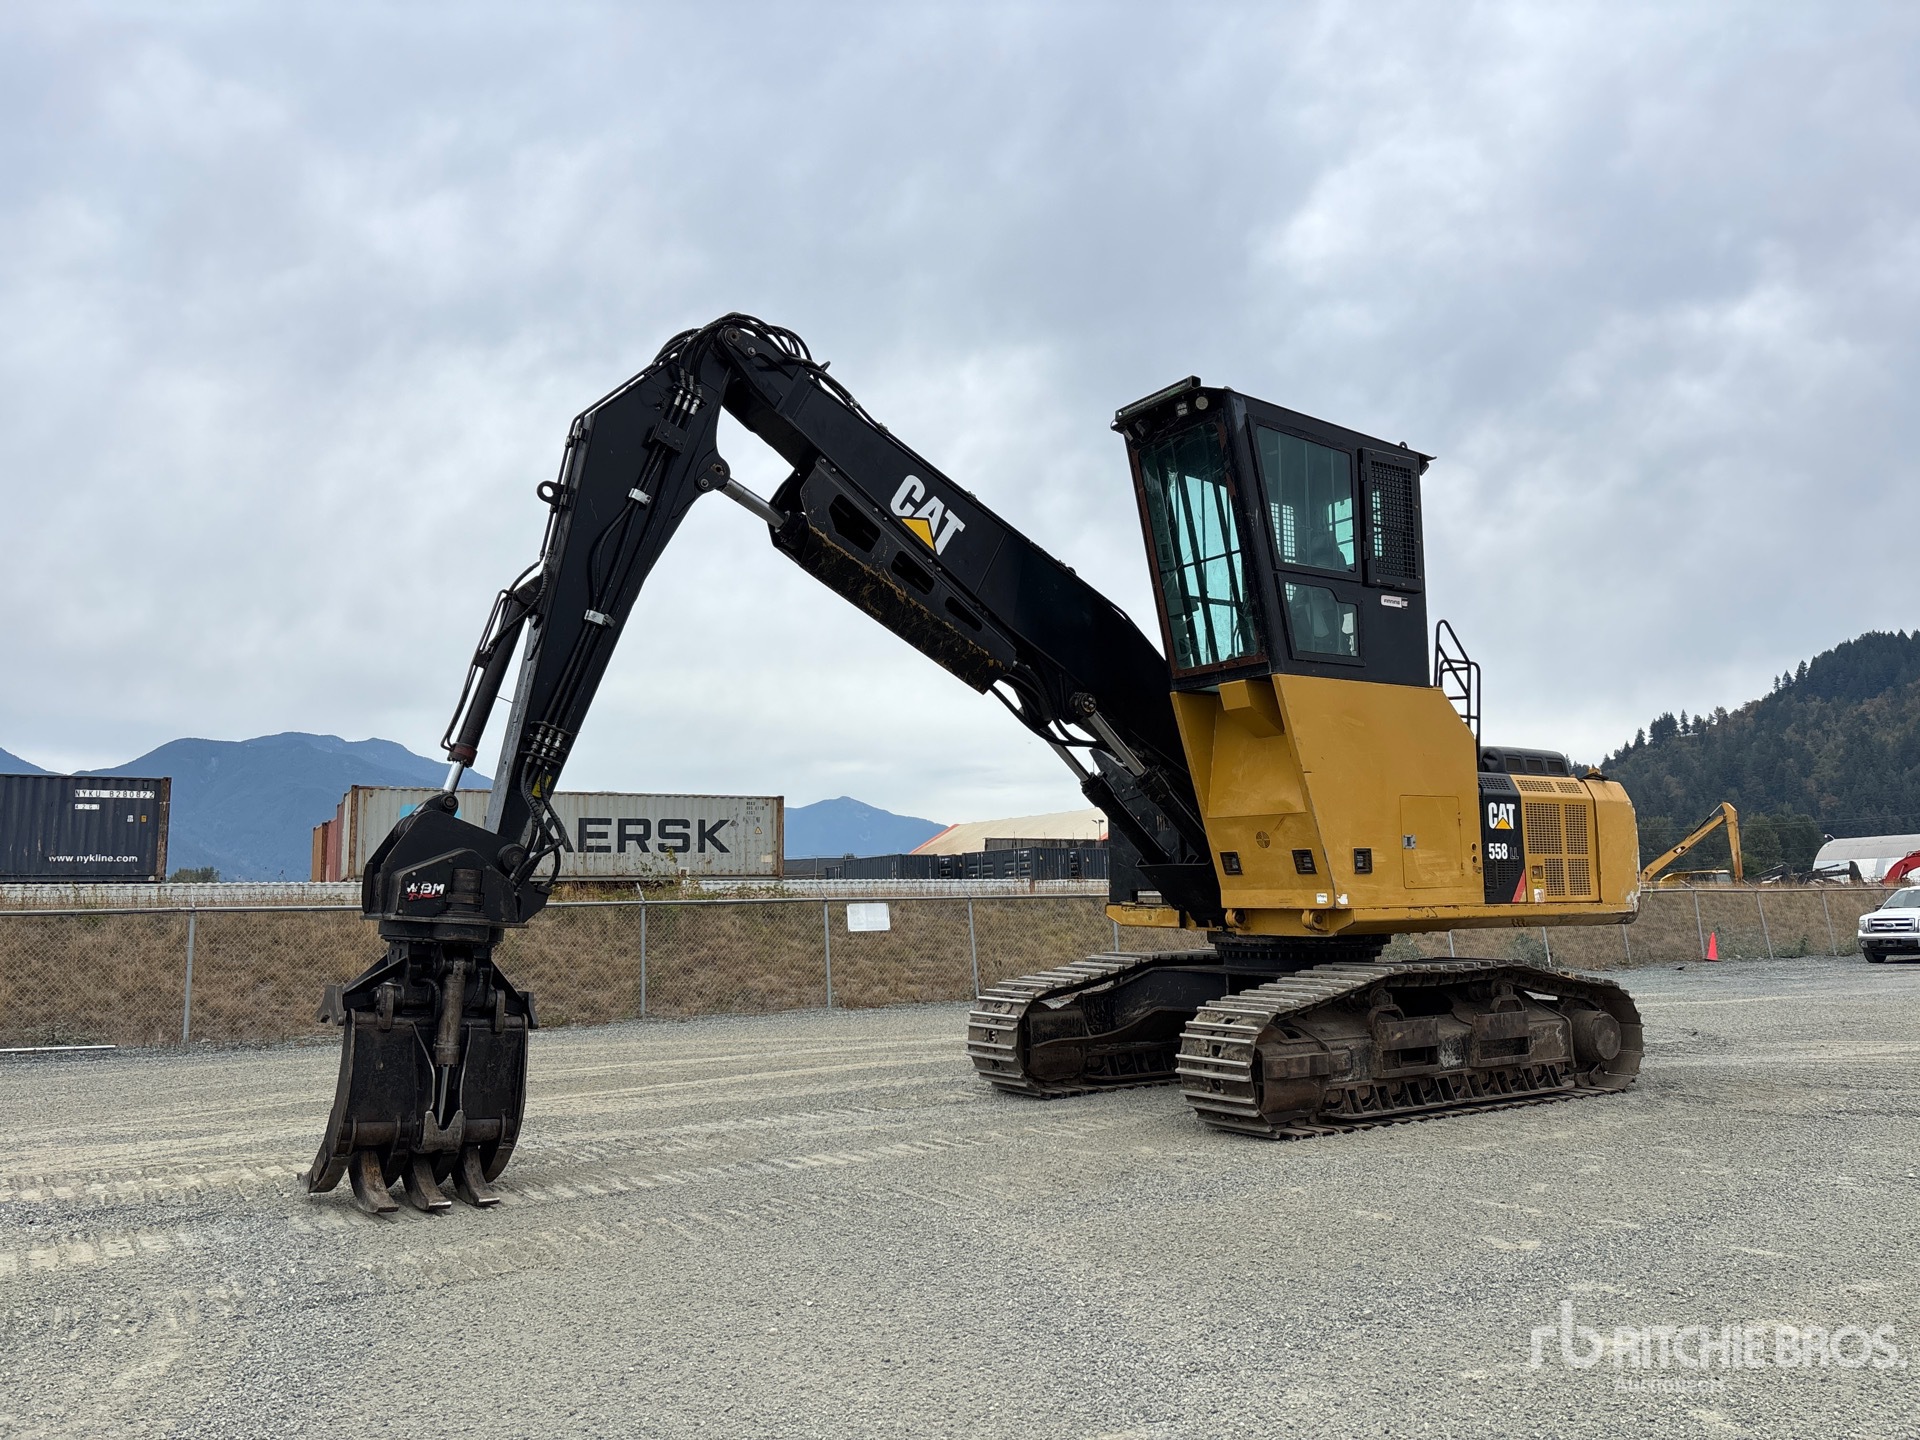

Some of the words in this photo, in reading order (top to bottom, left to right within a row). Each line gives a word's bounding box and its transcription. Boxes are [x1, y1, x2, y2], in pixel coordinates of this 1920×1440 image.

[890, 474, 966, 556] CAT
[75, 789, 100, 798] NYKU
[1488, 802, 1515, 830] CAT
[532, 817, 731, 853] AERSK
[48, 853, 138, 864] www.nykline.com
[1488, 843, 1508, 860] 558
